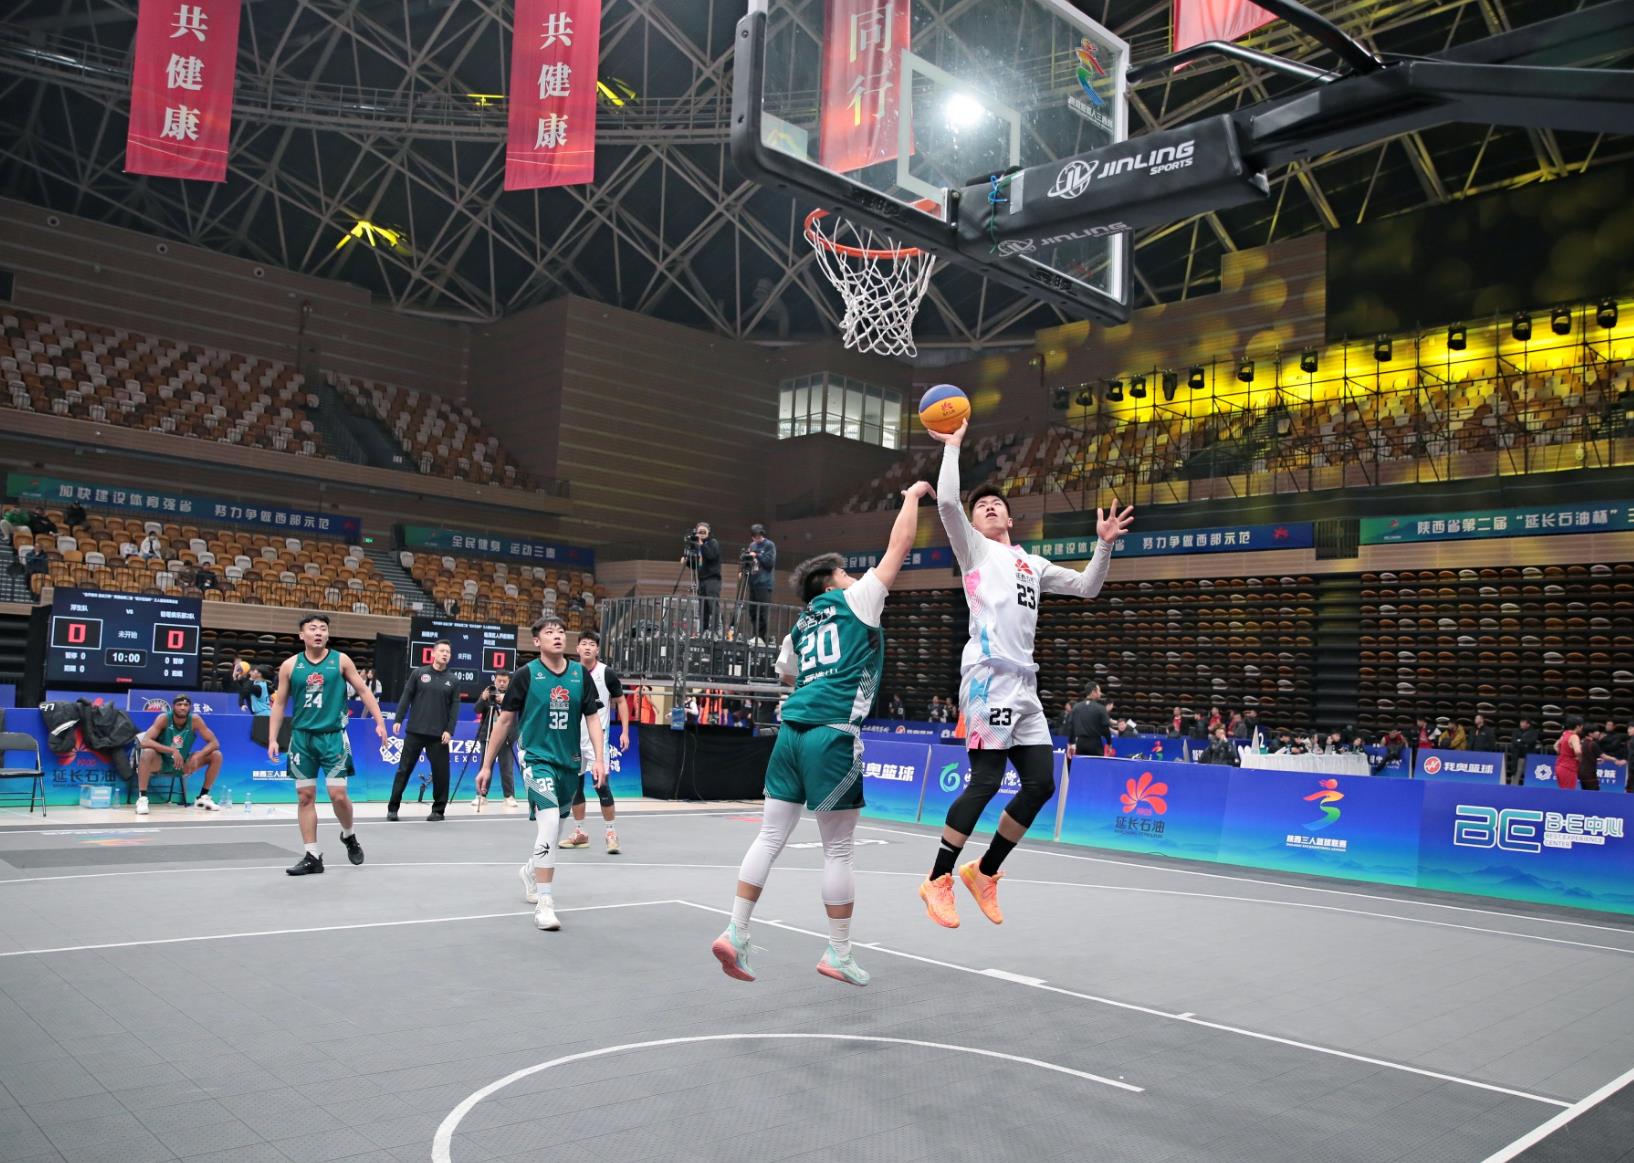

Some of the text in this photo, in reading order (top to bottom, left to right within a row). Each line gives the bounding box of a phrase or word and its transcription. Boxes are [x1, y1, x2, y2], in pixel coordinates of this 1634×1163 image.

[160, 4, 208, 141] 共健康
[847, 3, 893, 127] 同行
[533, 12, 574, 150] 共健康
[1097, 140, 1195, 179] JINLING
[1150, 157, 1193, 175] SPORTS
[59, 484, 331, 530] 加快建设体育强省 努力争做西部示范
[452, 535, 501, 552] 全民健身
[1031, 529, 1251, 556] 加快建设体育省 努力争做西部示范
[1016, 583, 1037, 610] 23
[68, 623, 87, 644] 0
[117, 630, 138, 640] 未开始
[167, 630, 185, 650] 0
[80, 652, 86, 661] 0
[799, 622, 842, 672] 20
[112, 652, 141, 664] 10:00
[492, 652, 507, 669] 0
[303, 692, 323, 709] 24
[549, 711, 569, 730] 32
[989, 707, 1013, 726] 23
[54, 768, 117, 783] 延长石油
[535, 777, 555, 793] 32
[1114, 815, 1166, 833] 延长石油
